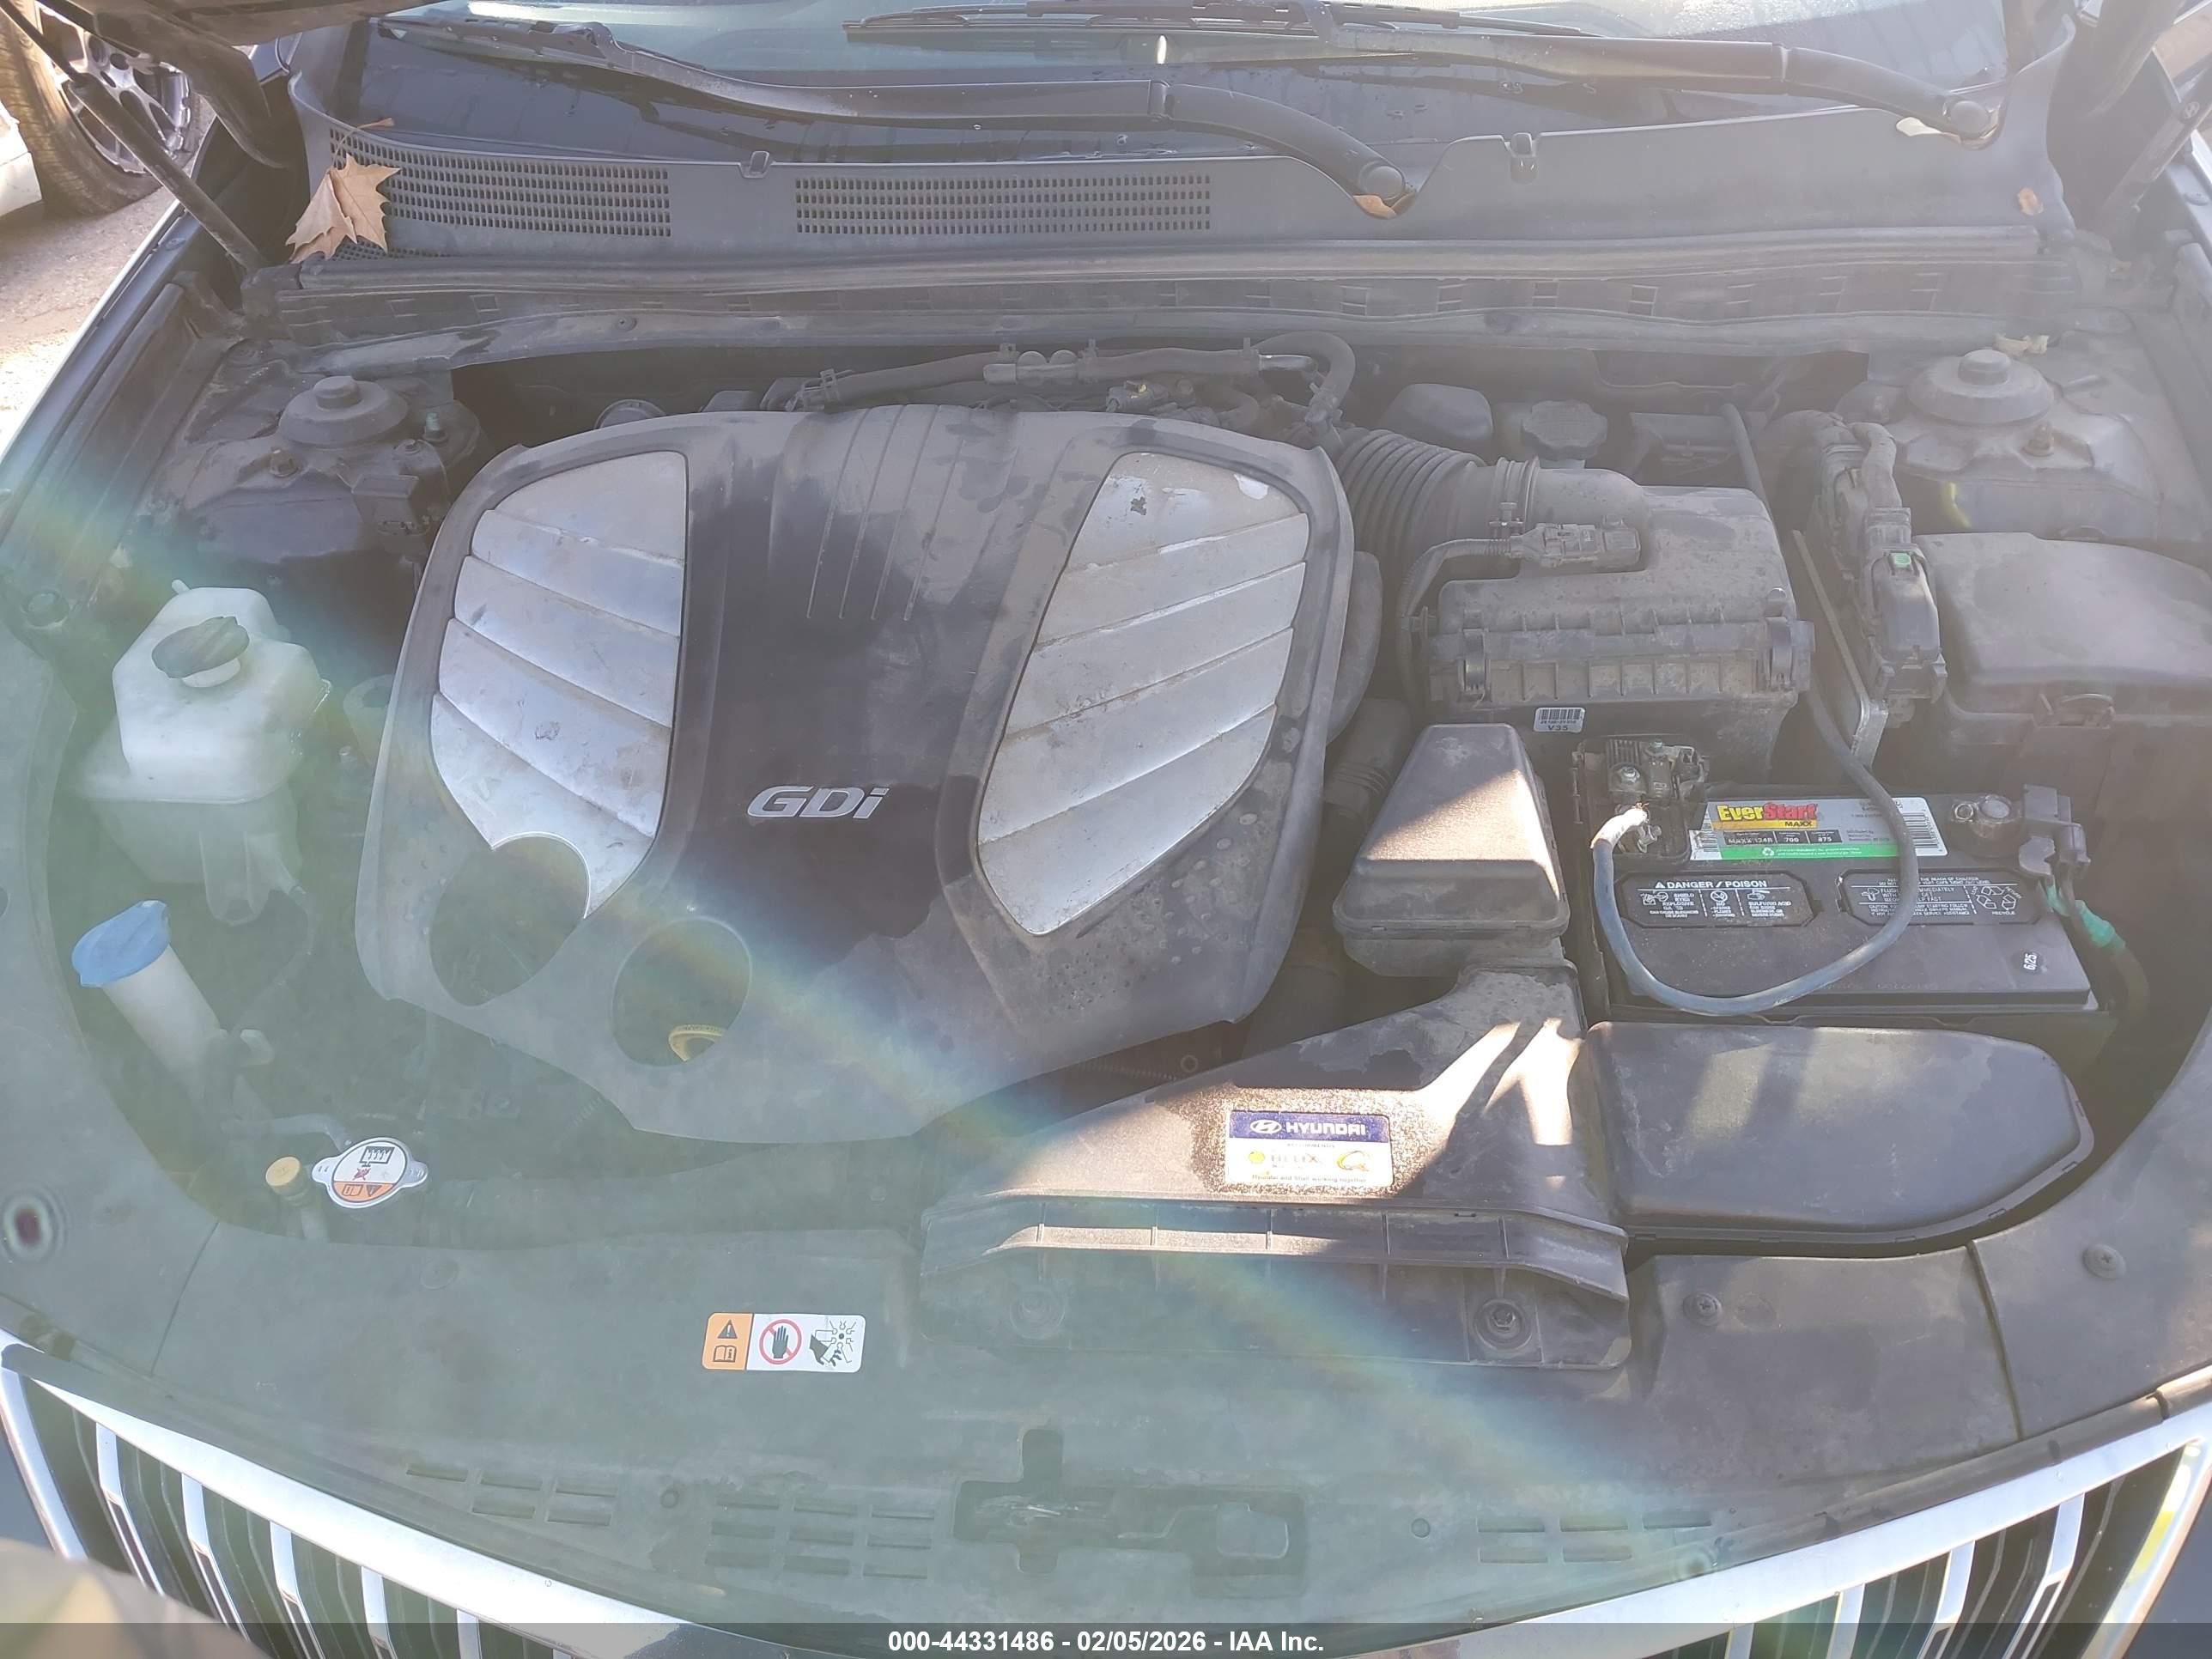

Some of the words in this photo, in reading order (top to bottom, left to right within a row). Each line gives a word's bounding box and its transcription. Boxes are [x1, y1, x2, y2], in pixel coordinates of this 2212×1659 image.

[747, 785, 890, 819] GDi
[1717, 802, 1818, 822] EverStart
[2023, 953, 2038, 970] 6/25
[1285, 1121, 1366, 1135] HYUNDAI
